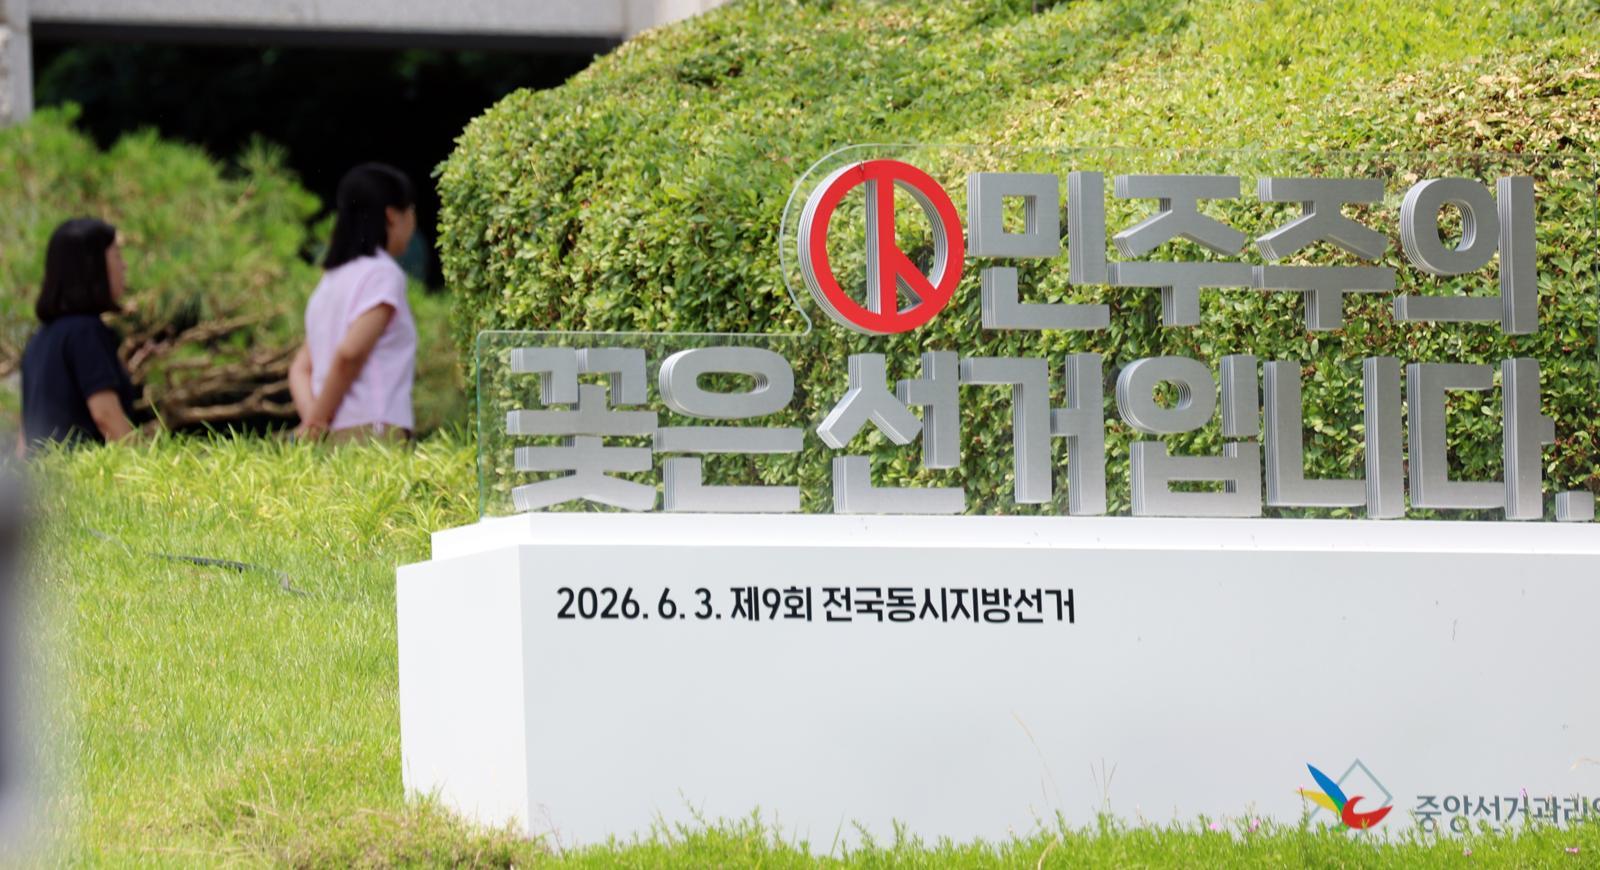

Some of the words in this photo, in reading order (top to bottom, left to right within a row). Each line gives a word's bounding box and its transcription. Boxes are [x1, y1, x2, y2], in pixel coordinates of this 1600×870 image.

[967, 171, 1538, 335] 민주주의
[506, 346, 804, 512] 꽃은
[816, 350, 1595, 521] 선거입니다.
[557, 587, 649, 620] 2026.
[658, 587, 686, 620] 6.
[694, 587, 722, 620] 3.
[730, 586, 812, 622] 제9회
[822, 587, 1075, 624] 전국동시지방선거
[1414, 795, 1600, 833] 중앙선거관리
